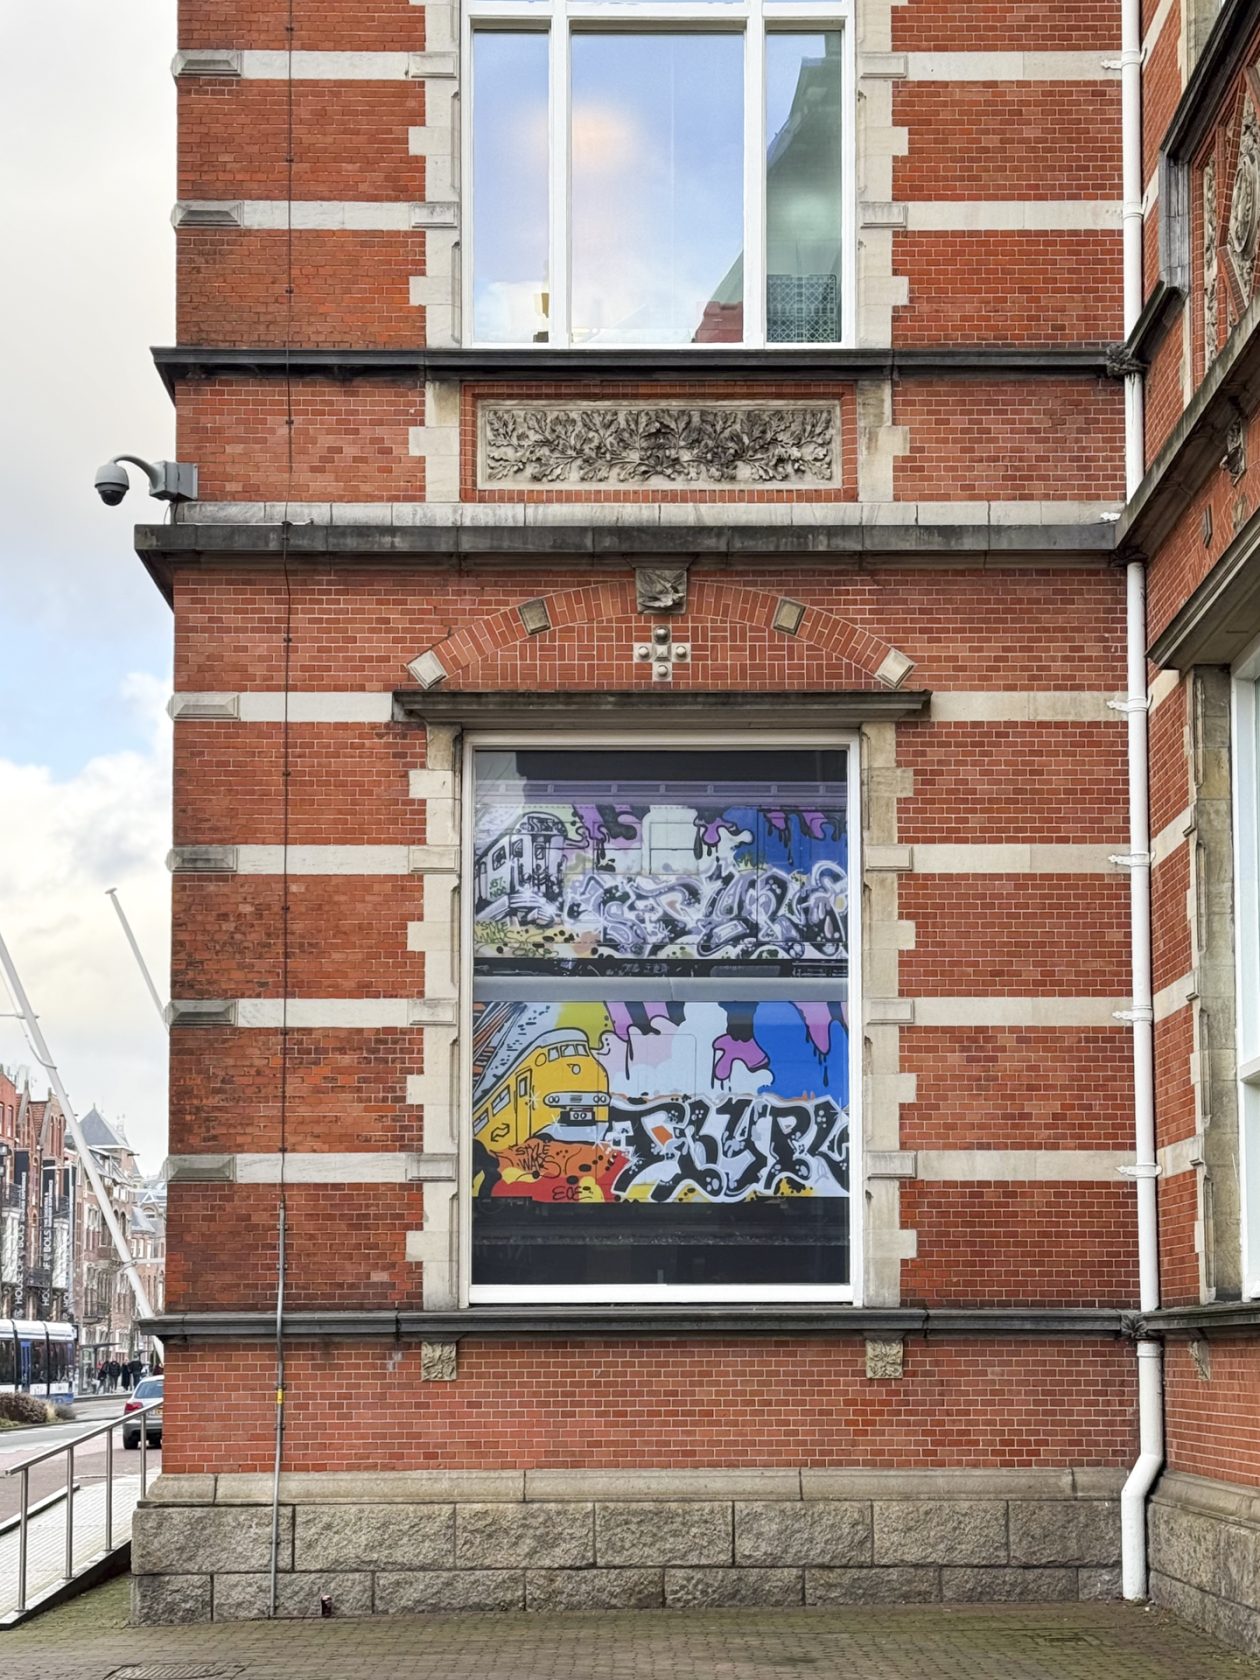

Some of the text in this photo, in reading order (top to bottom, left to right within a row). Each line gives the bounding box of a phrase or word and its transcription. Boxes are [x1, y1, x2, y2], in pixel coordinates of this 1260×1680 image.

[515, 1142, 551, 1161] STYLE
[17, 1225, 25, 1249] BOLS
[43, 1229, 52, 1253] BOLS
[14, 1272, 24, 1305] HOUSE
